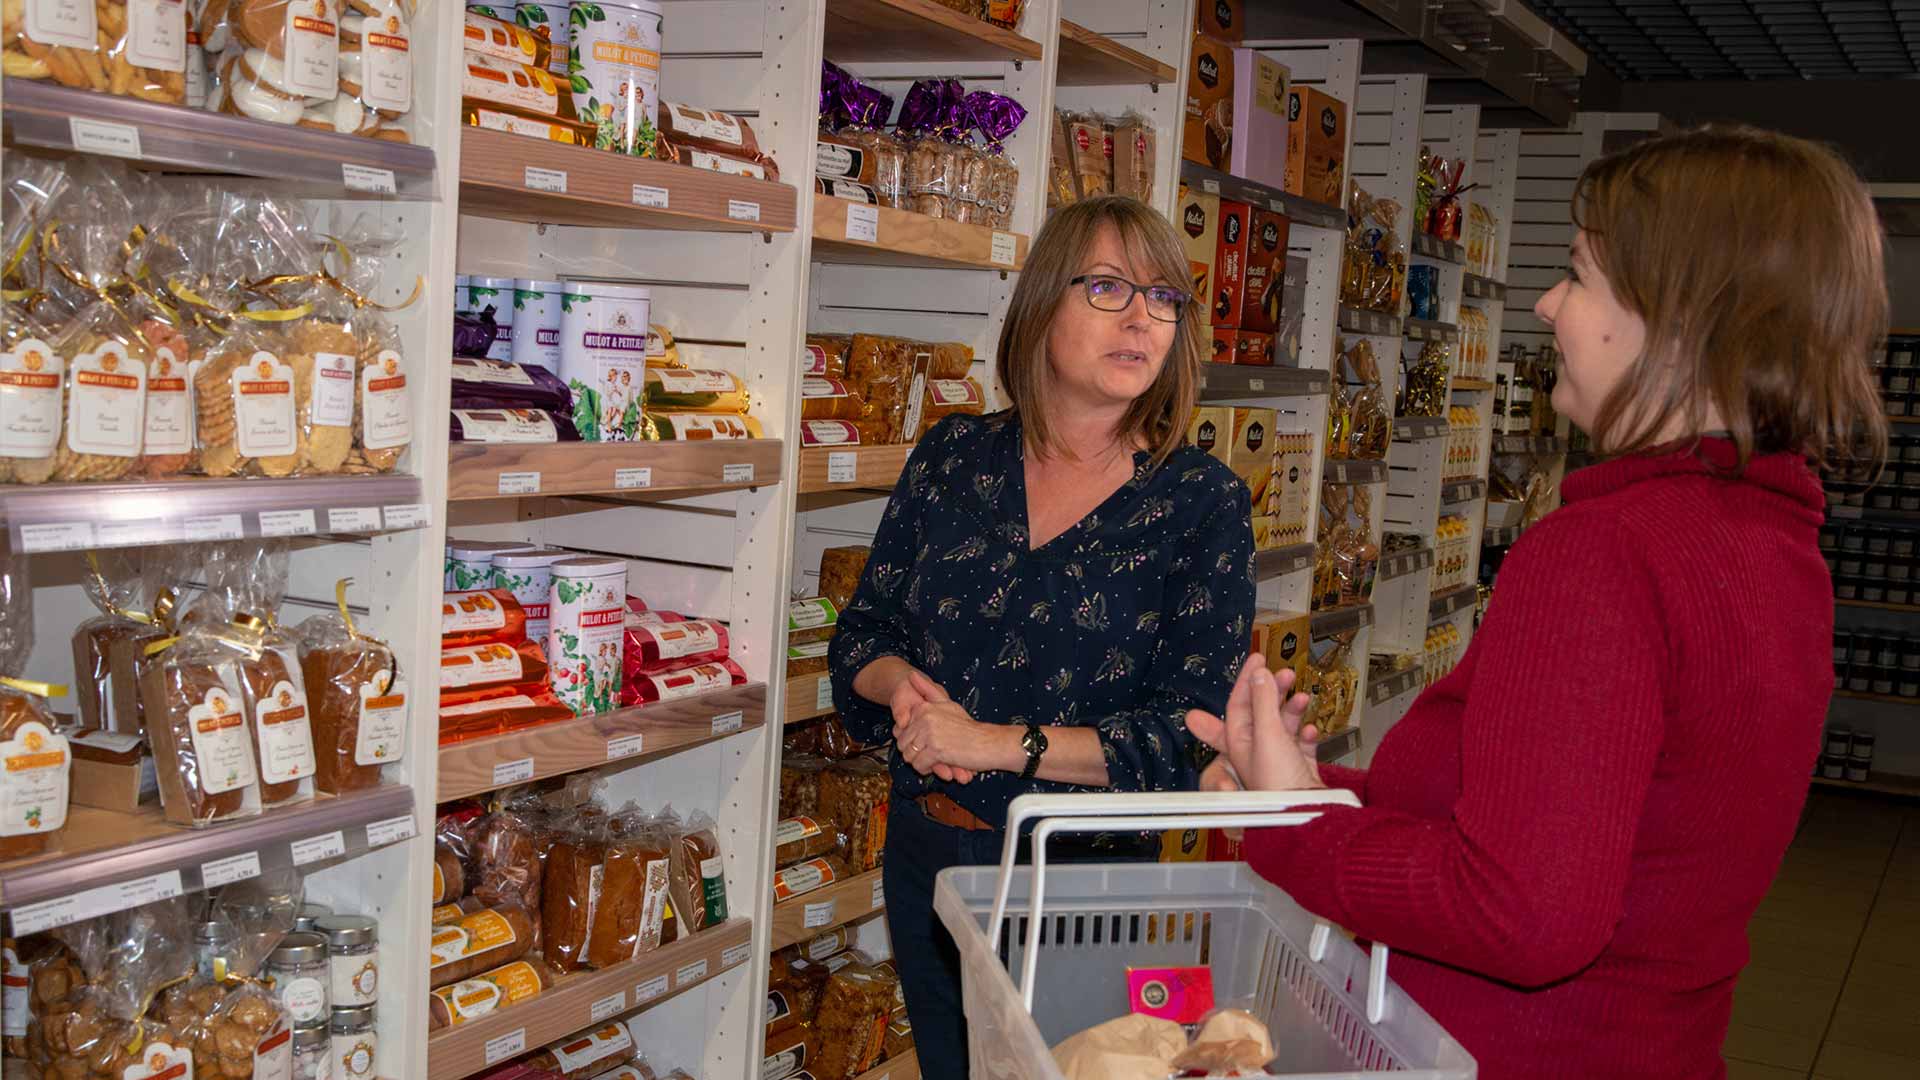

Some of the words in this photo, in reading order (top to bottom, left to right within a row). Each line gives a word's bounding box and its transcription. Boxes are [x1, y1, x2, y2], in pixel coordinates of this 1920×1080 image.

[596, 46, 622, 60] MULOT
[538, 332, 559, 343] MULO
[585, 335, 611, 347] MULOT
[611, 336, 618, 348] &
[580, 612, 602, 625] MULOT
